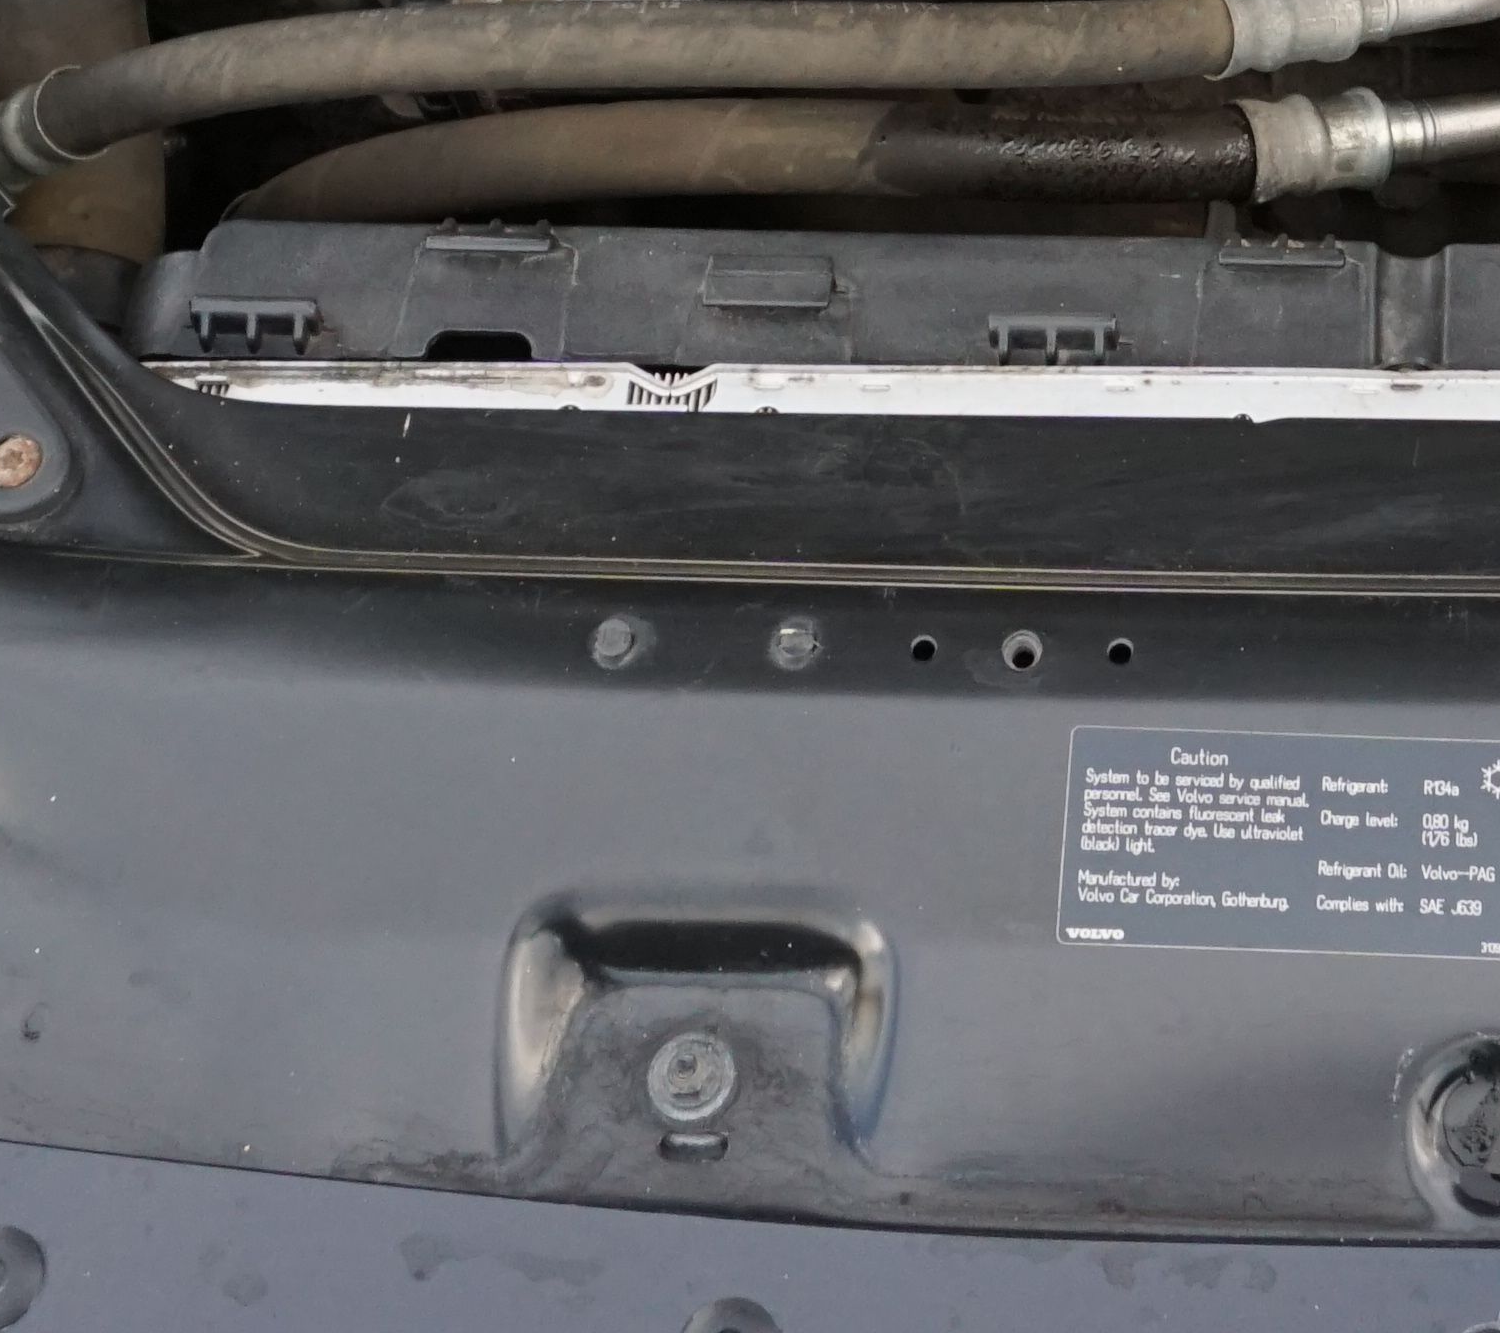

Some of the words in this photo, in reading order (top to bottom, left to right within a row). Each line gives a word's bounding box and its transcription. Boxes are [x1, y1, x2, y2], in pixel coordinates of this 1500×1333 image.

[1170, 747, 1229, 766] Caution
[1086, 769, 1129, 788] System
[1137, 771, 1149, 785] to
[1154, 772, 1169, 787] be
[1175, 773, 1225, 789] serviced
[1229, 774, 1244, 791] by
[1250, 775, 1300, 792] qualified
[1322, 777, 1389, 796] Refrigerant:
[1424, 780, 1459, 797] R134a
[1083, 787, 1142, 803] personnel.
[1148, 788, 1170, 803] See
[1177, 789, 1214, 804] Volvo
[1219, 791, 1261, 806] service
[1266, 792, 1309, 808] manual.
[1082, 802, 1129, 820] System
[1132, 804, 1182, 821] contains
[1189, 805, 1254, 822] fluorescent
[1260, 809, 1285, 824] leak
[1320, 811, 1360, 829] Charge
[1366, 811, 1398, 829] level:
[1454, 815, 1469, 833] kg
[1081, 819, 1138, 835] detection
[1144, 822, 1177, 837] tracer
[1183, 824, 1208, 841] dye.
[1213, 825, 1235, 840] Use
[1240, 826, 1304, 842] ultraviolet
[1455, 832, 1478, 848] lbs)
[1080, 836, 1120, 853] (black)
[1125, 838, 1156, 855] light.
[1077, 870, 1158, 887] Manufactured
[1161, 872, 1180, 889] by:
[1317, 861, 1383, 881] Refrigerant
[1388, 863, 1407, 879] Oil:
[1077, 887, 1115, 903] Volvo
[1120, 888, 1140, 903] Car
[1145, 890, 1217, 908] Corporation,
[1316, 896, 1368, 914] Complies
[1375, 897, 1404, 913] with:
[1419, 898, 1445, 915] SAE
[1450, 900, 1482, 917] J639
[1065, 928, 1125, 941] VOLVO
